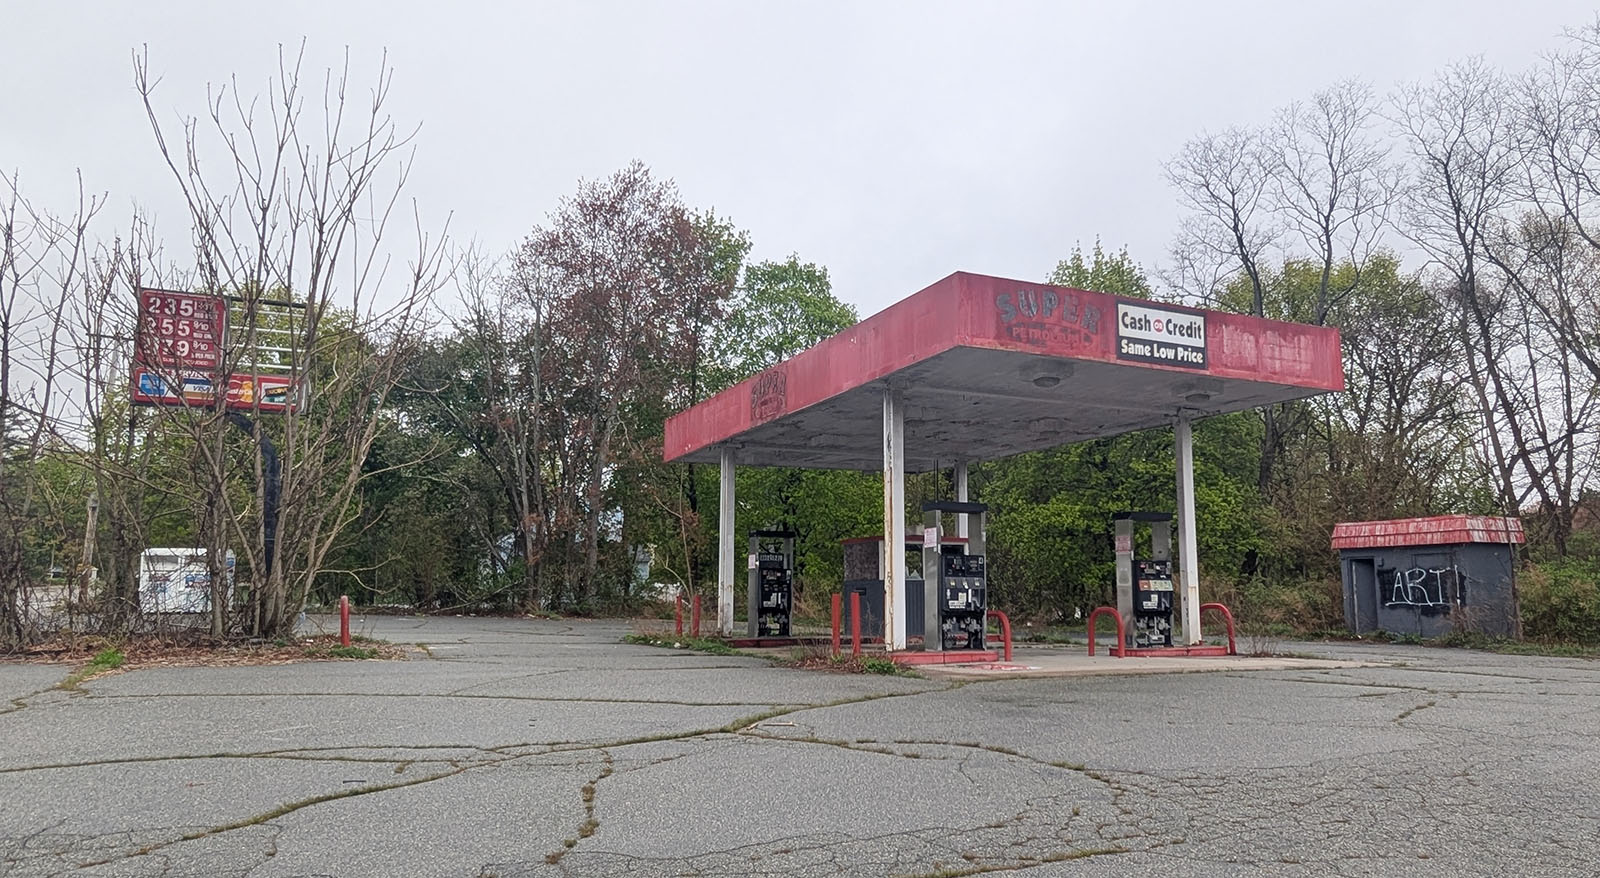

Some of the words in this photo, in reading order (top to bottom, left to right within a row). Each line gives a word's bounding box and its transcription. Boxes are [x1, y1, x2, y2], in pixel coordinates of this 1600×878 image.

[148, 297, 193, 317] 235
[996, 289, 1101, 334] SUPER
[1121, 312, 1151, 332] Cash
[1166, 318, 1202, 339] Credit
[1121, 339, 1151, 356] Same
[1153, 344, 1175, 359] Low
[1177, 347, 1203, 363] Price
